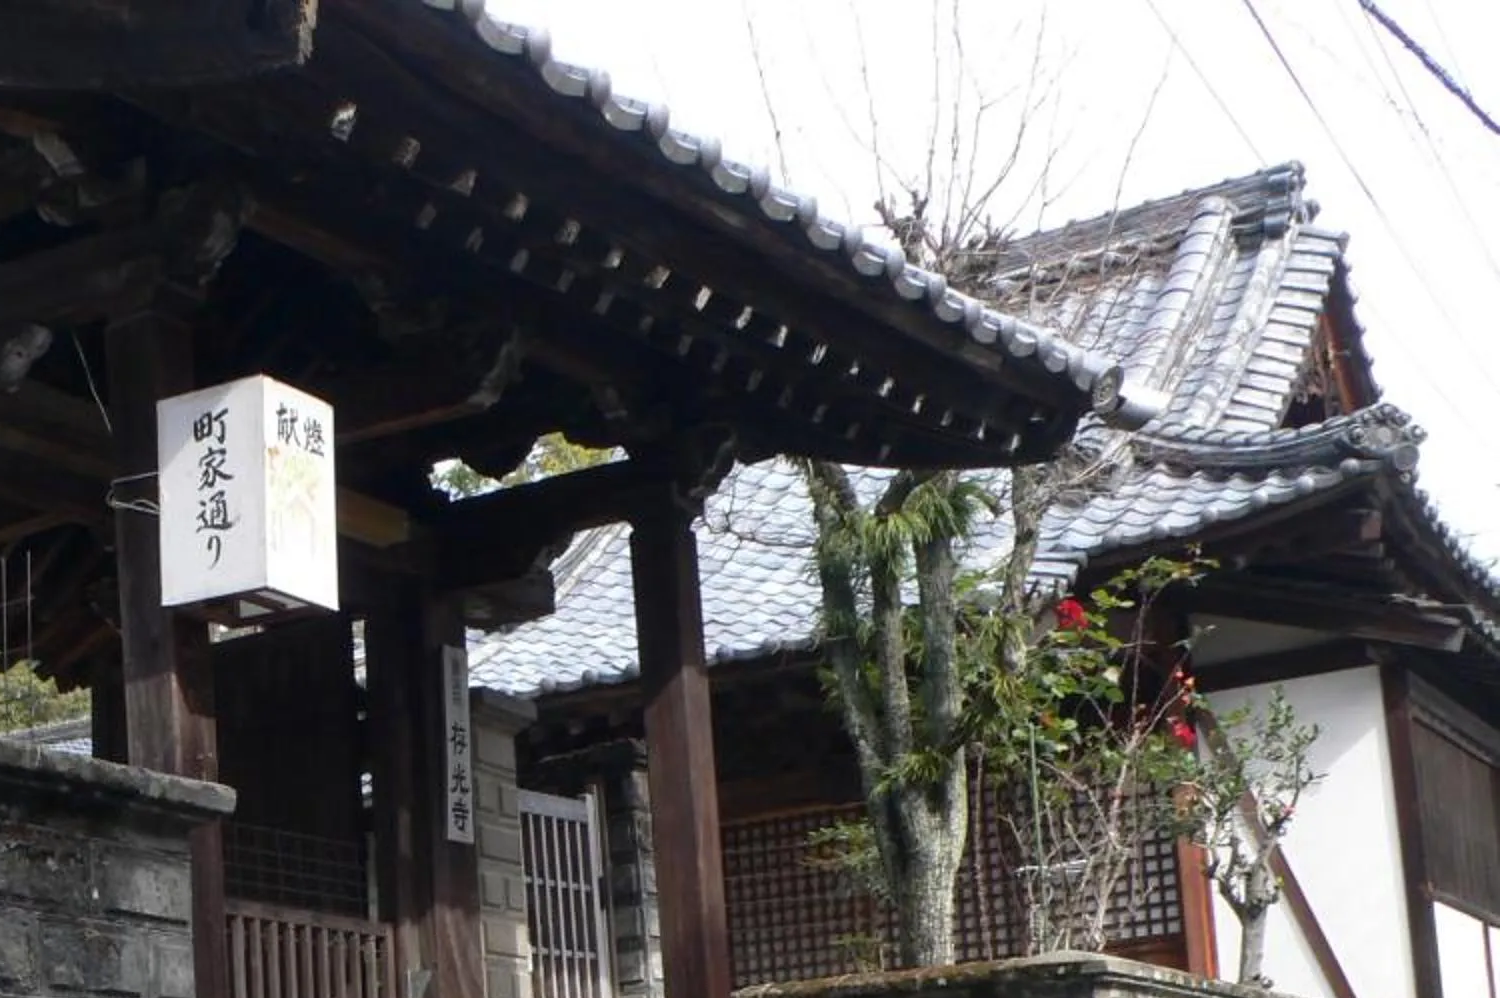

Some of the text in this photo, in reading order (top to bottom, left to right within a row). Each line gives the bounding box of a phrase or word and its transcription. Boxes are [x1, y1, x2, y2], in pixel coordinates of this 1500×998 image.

[193, 408, 236, 570] 町家通り
[450, 720, 470, 831] 存光寺
